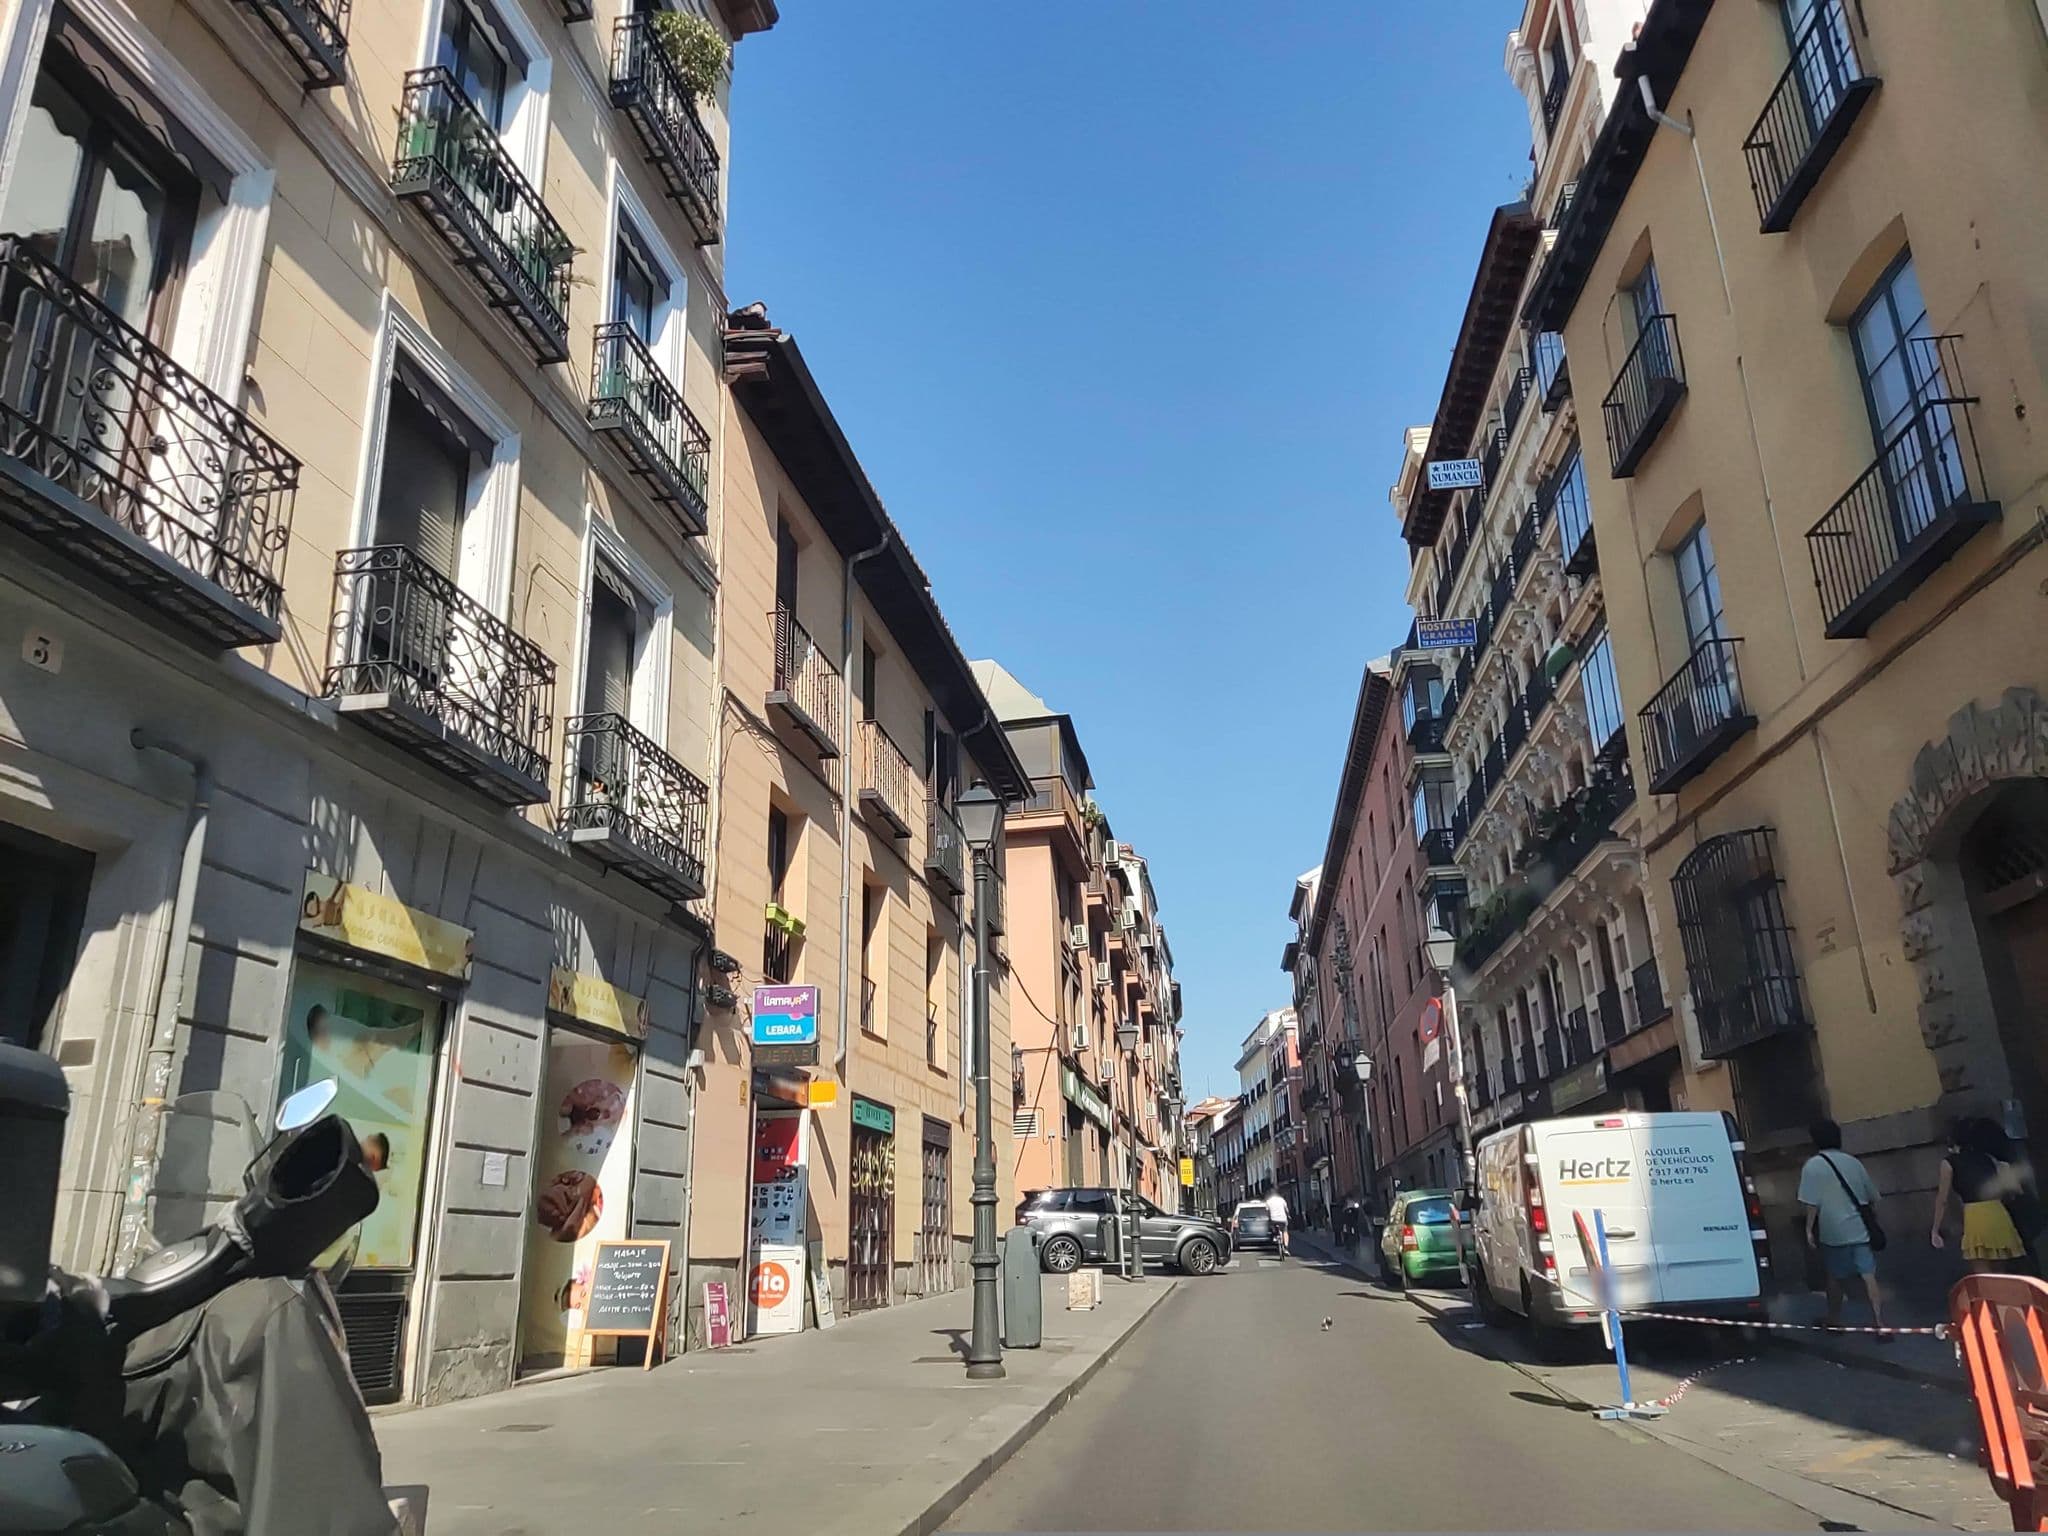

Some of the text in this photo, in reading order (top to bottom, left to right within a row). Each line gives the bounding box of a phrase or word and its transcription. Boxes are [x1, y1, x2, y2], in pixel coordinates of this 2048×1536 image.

[1442, 461, 1478, 471] HOSTAL
[1431, 470, 1479, 482] NUMANCIA
[1422, 630, 1473, 640] GRACIELA
[766, 1025, 802, 1035] LEBARA
[1644, 1147, 1691, 1157] ALQUILER
[1645, 1158, 1658, 1166] DE
[1560, 1157, 1630, 1179] Hertz
[1655, 1168, 1671, 1176] 917
[1693, 1166, 1709, 1174] 765
[1703, 1224, 1739, 1232] RENAULT
[752, 1266, 785, 1291] ria
